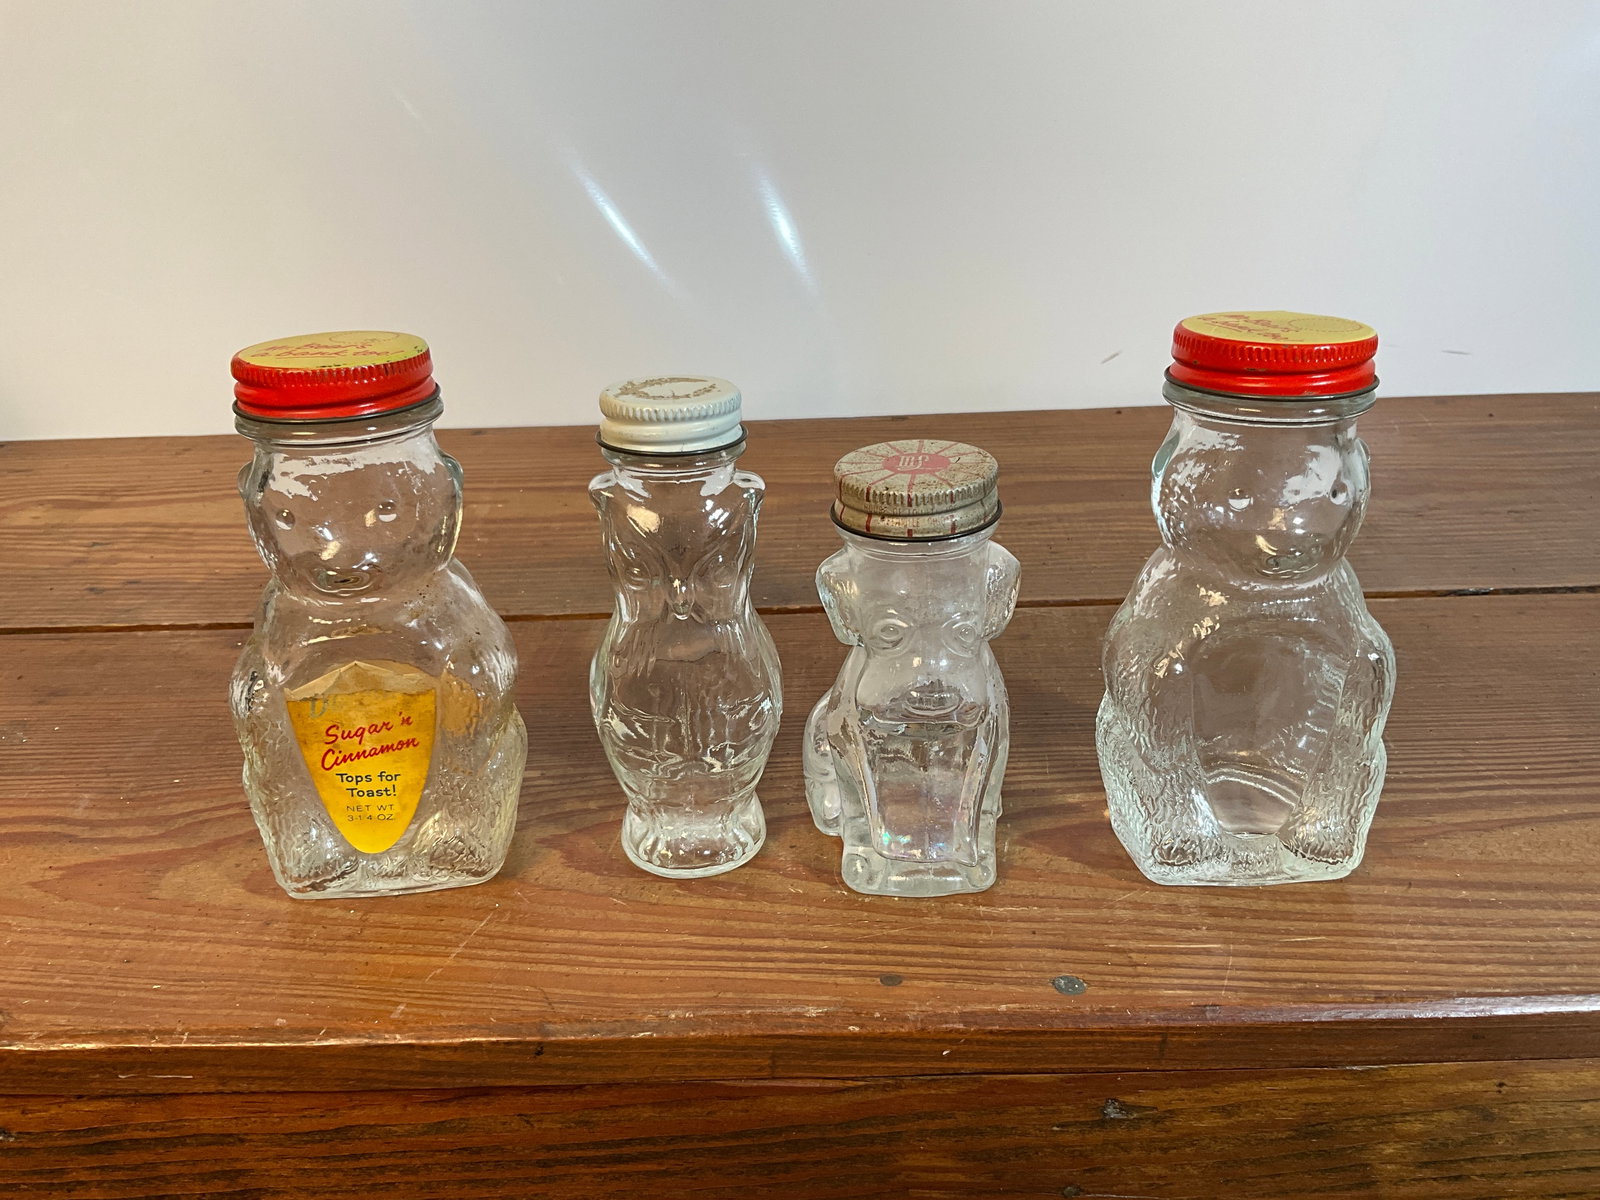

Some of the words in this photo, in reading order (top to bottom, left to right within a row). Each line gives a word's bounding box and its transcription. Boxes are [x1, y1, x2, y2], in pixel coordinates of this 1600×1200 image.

[324, 721, 394, 746] Sugar
[321, 737, 420, 771] Cinnamon
[335, 772, 373, 785] Tops
[377, 770, 401, 782] for
[345, 784, 397, 798] Toast!
[346, 804, 372, 812] NET
